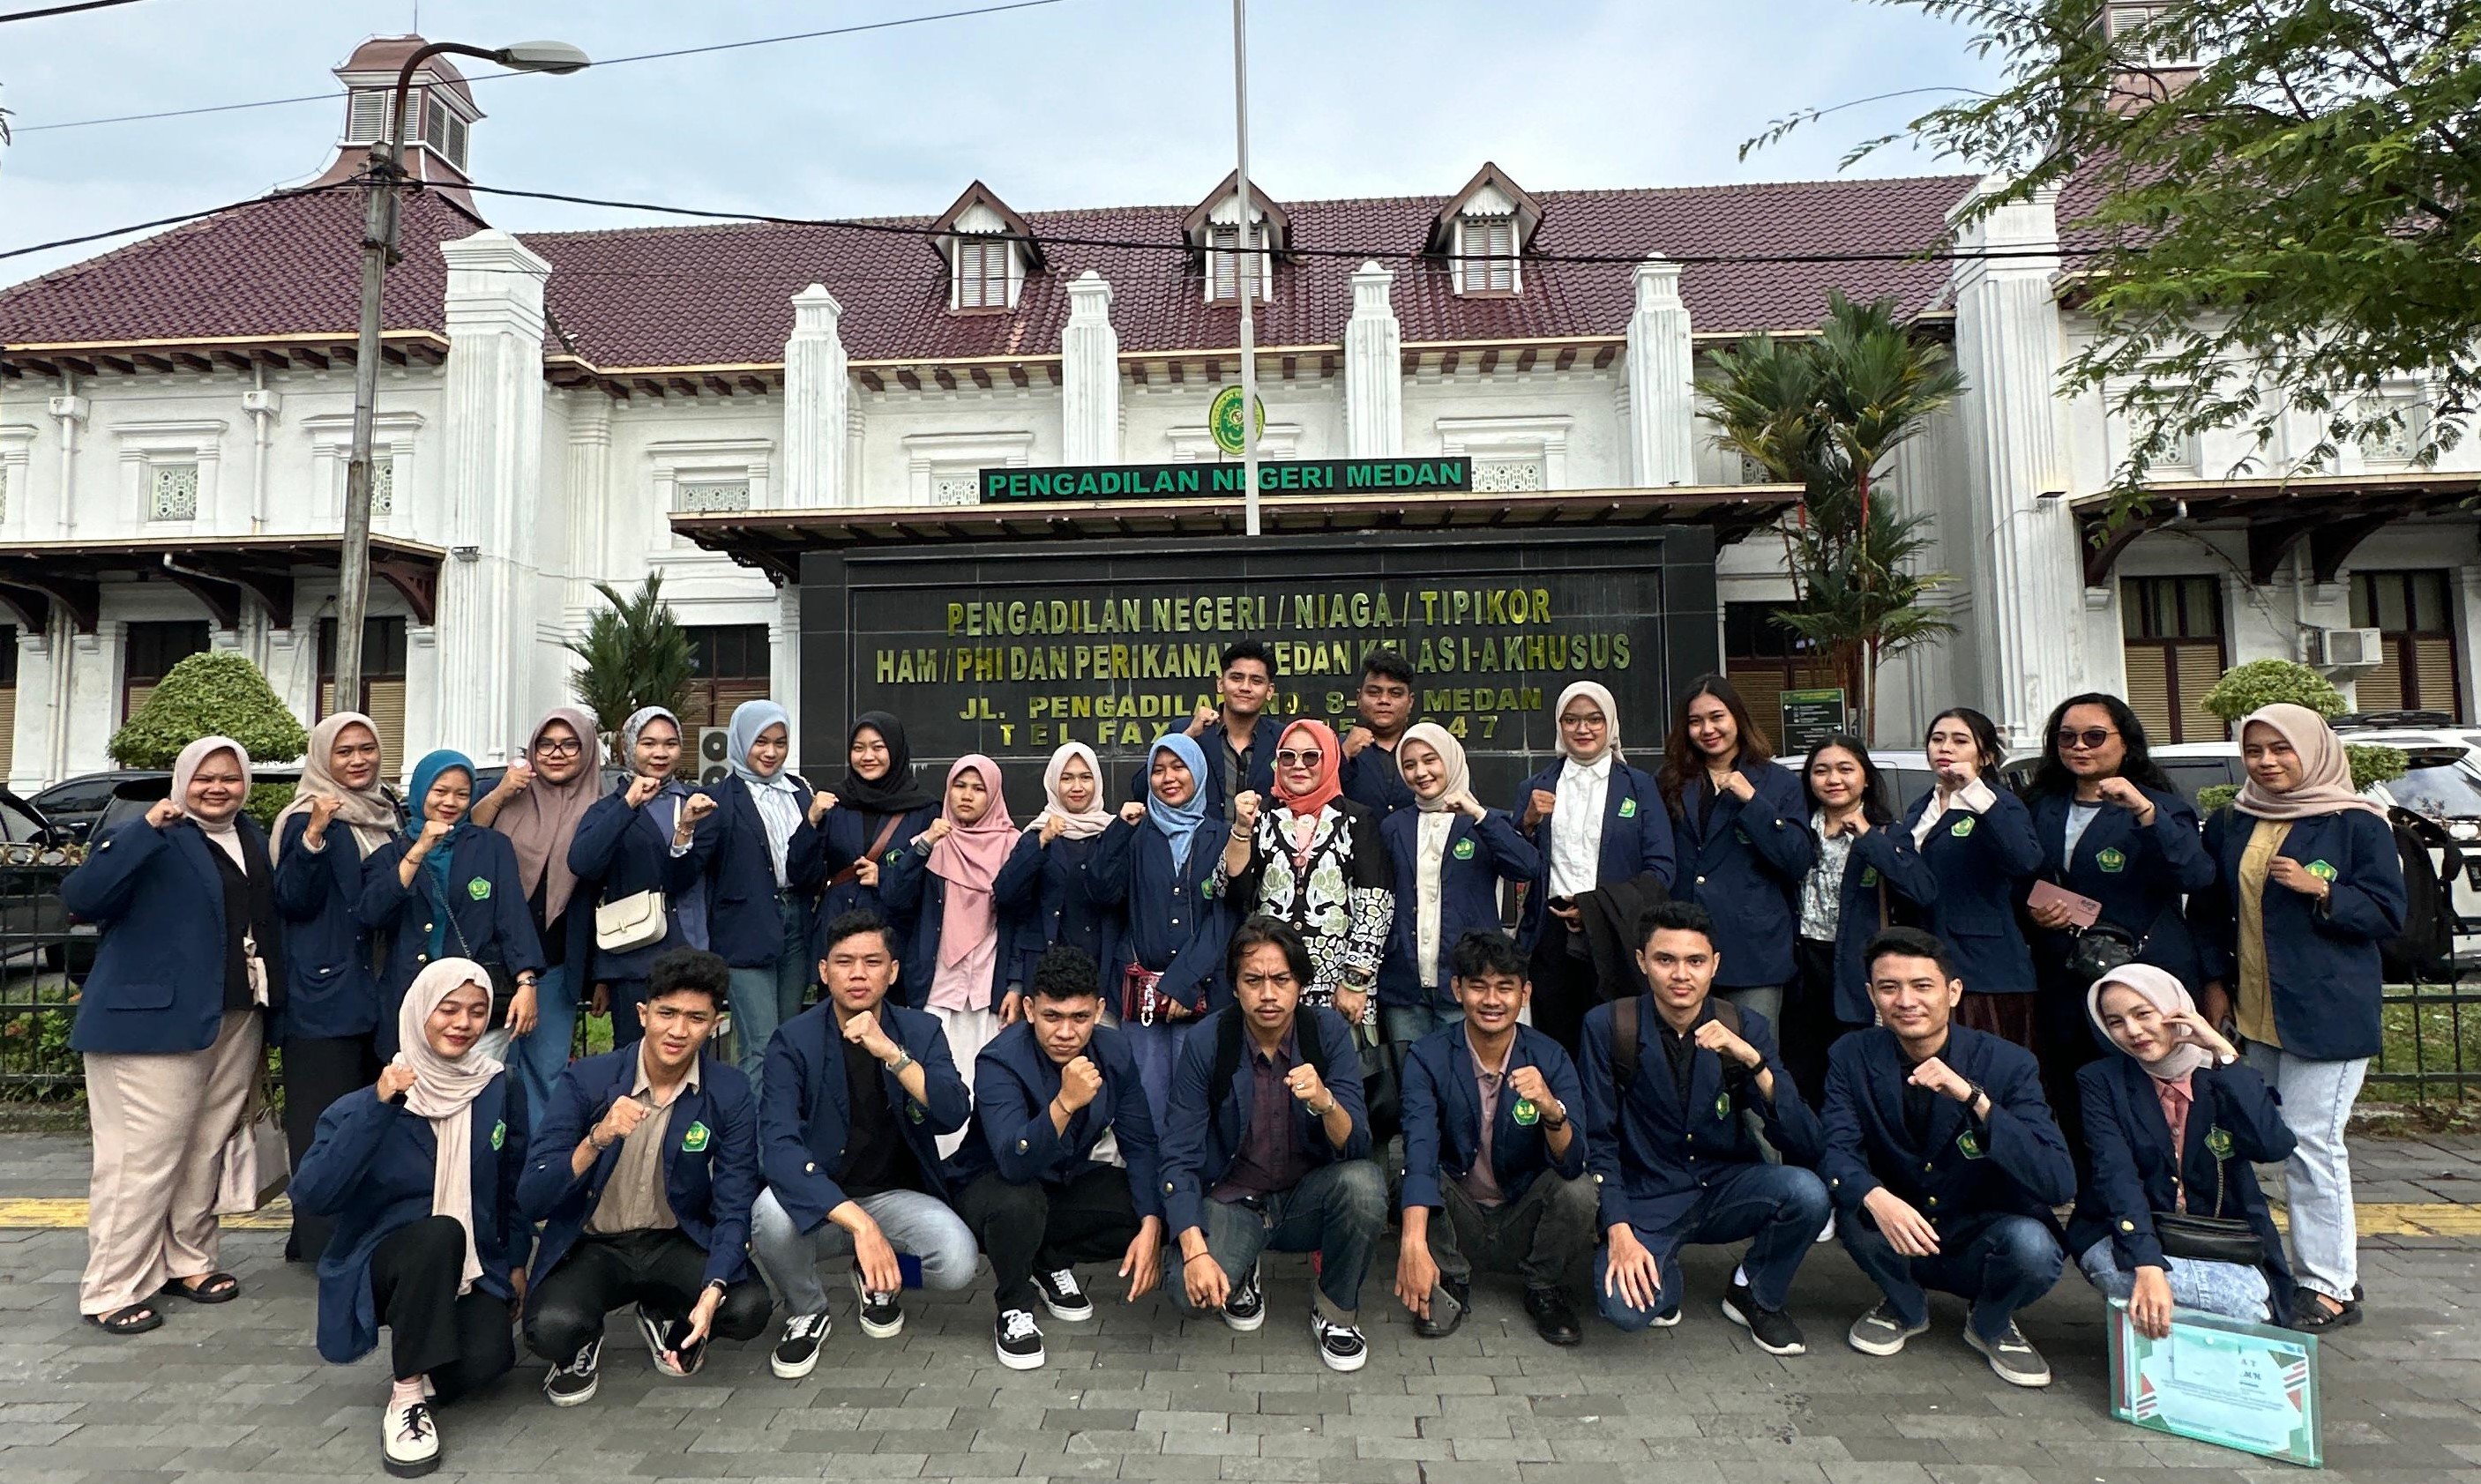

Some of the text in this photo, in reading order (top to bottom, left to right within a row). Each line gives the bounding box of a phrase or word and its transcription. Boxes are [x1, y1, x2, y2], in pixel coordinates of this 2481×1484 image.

[989, 470, 1199, 497] PENGADILAN
[1347, 462, 1462, 488] MEDAN
[947, 589, 1551, 637] PENGADILAN NEGERI / NIAGA / TIPIKOR
[877, 649, 938, 683] HAM
[957, 647, 1004, 682] PHI
[1010, 646, 1068, 681] DAN
[1075, 642, 1231, 680] PERIKANA
[1262, 640, 1352, 675] EDAN
[1504, 633, 1631, 671] KHUSUS
[959, 698, 1006, 720] JL.
[1423, 687, 1542, 712] MEDAN
[1000, 722, 1076, 746] TEL
